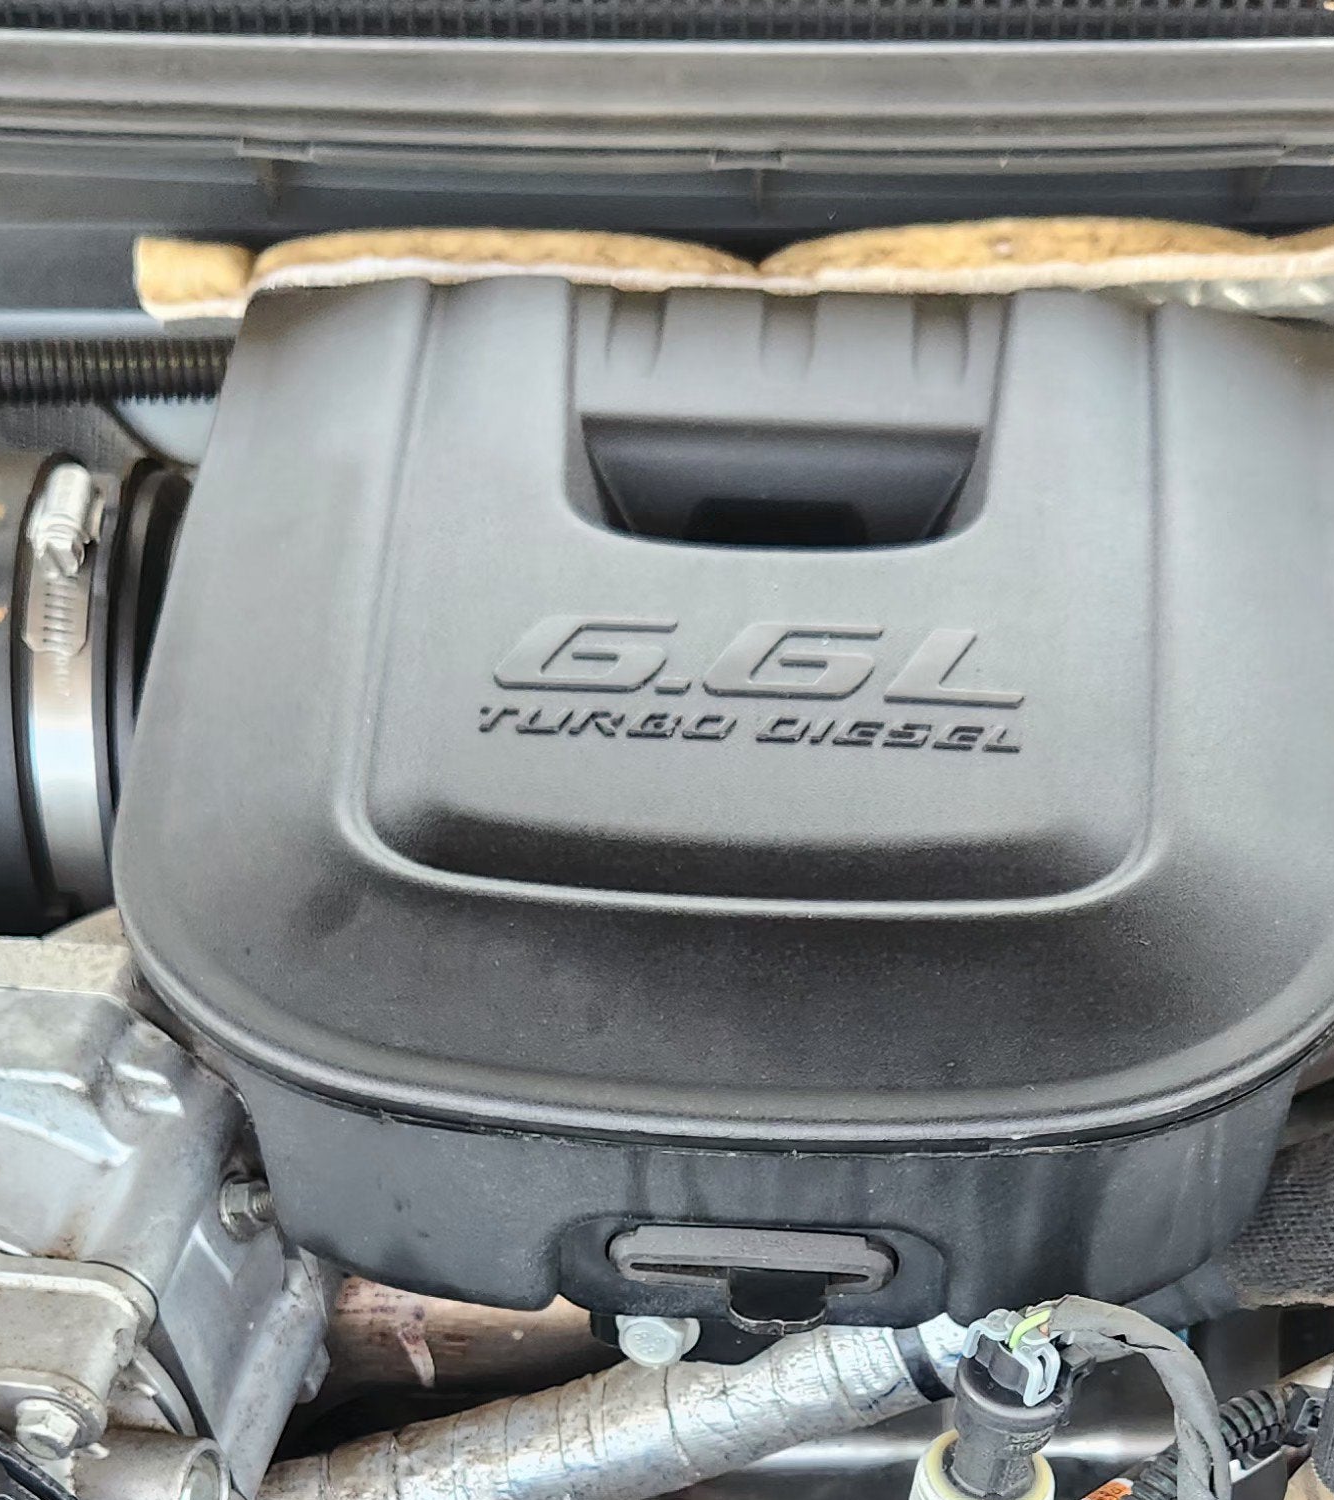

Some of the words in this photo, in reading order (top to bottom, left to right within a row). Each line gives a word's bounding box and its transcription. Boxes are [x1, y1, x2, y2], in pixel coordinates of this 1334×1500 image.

[492, 612, 1024, 709] 6.6L
[478, 703, 738, 742] TURBO
[755, 715, 1023, 754] DIESEL
